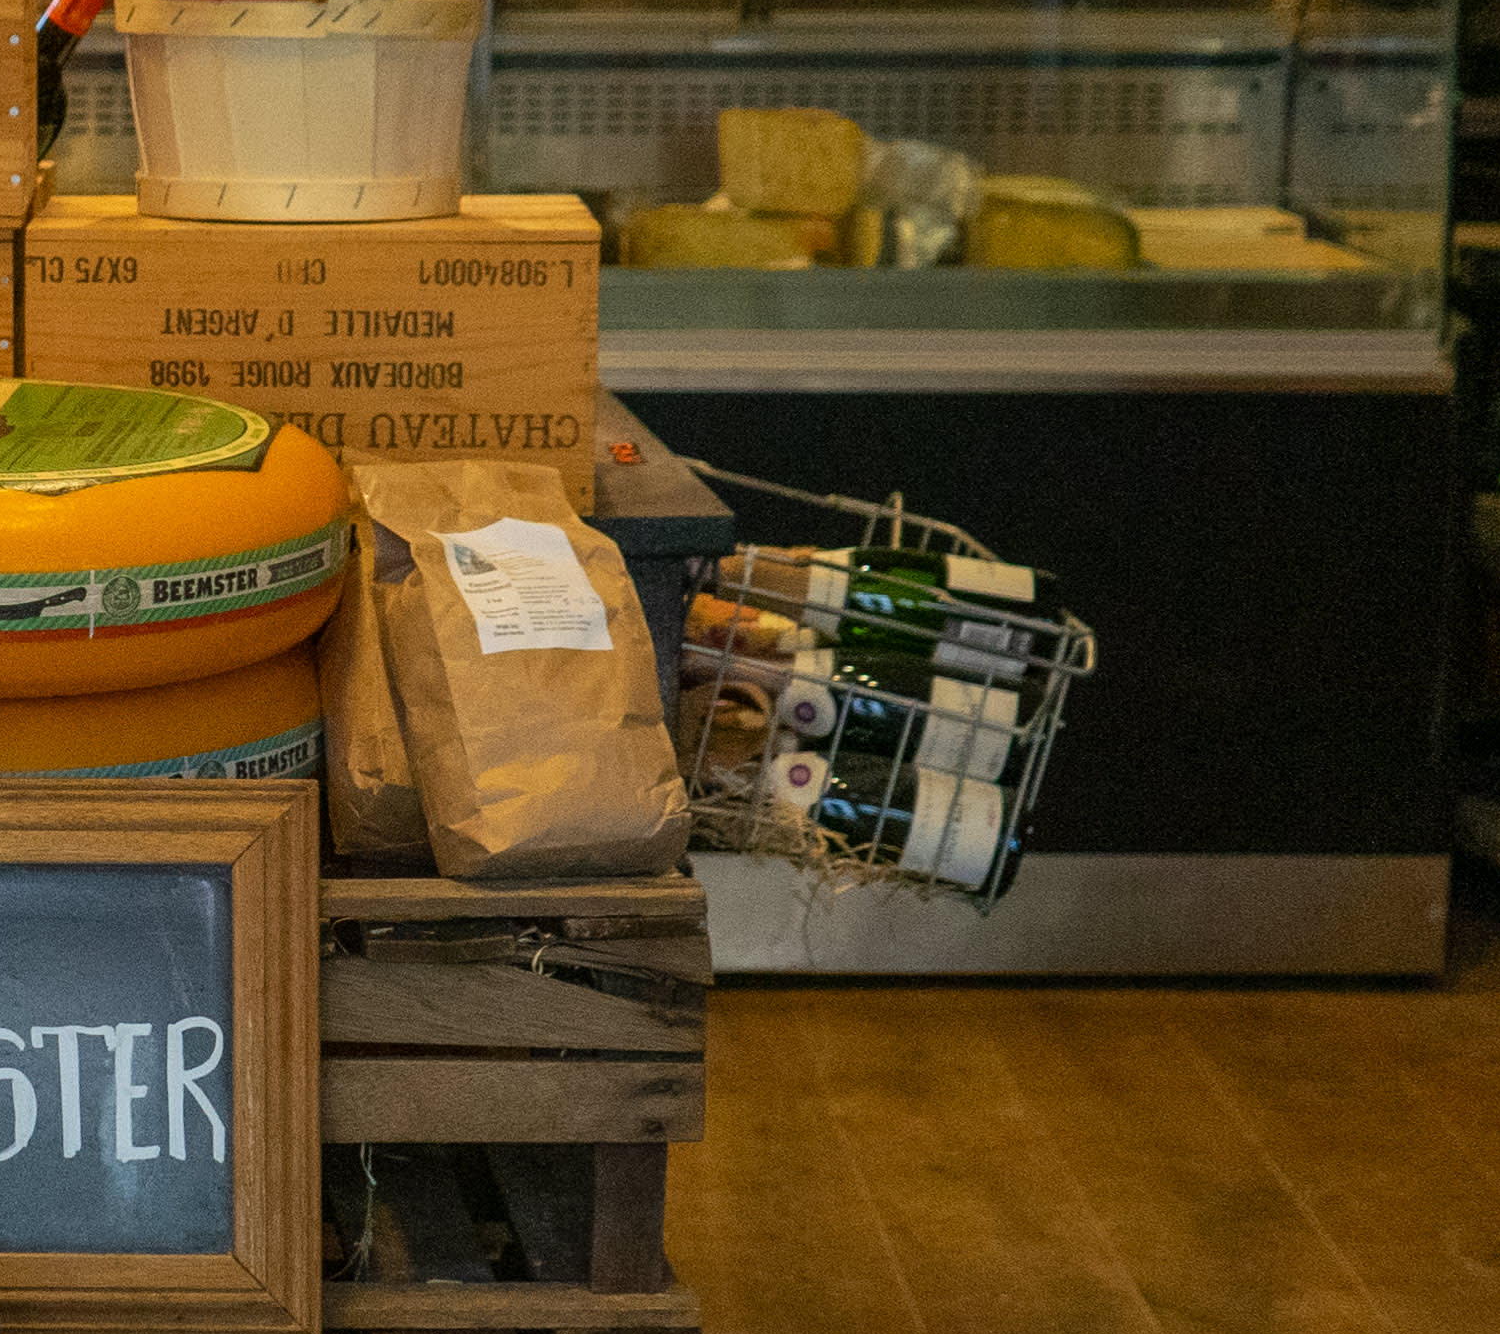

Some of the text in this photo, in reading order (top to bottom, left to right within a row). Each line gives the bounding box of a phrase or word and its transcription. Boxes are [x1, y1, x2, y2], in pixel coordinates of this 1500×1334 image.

[73, 257, 138, 285] 6X75
[322, 309, 455, 338] MEDAILLE
[149, 359, 463, 389] BORDEAUX ROUGE 1998
[368, 412, 580, 450] CHATEAU
[153, 567, 259, 604] BEEMSTER
[236, 742, 309, 779] BEEMSTER
